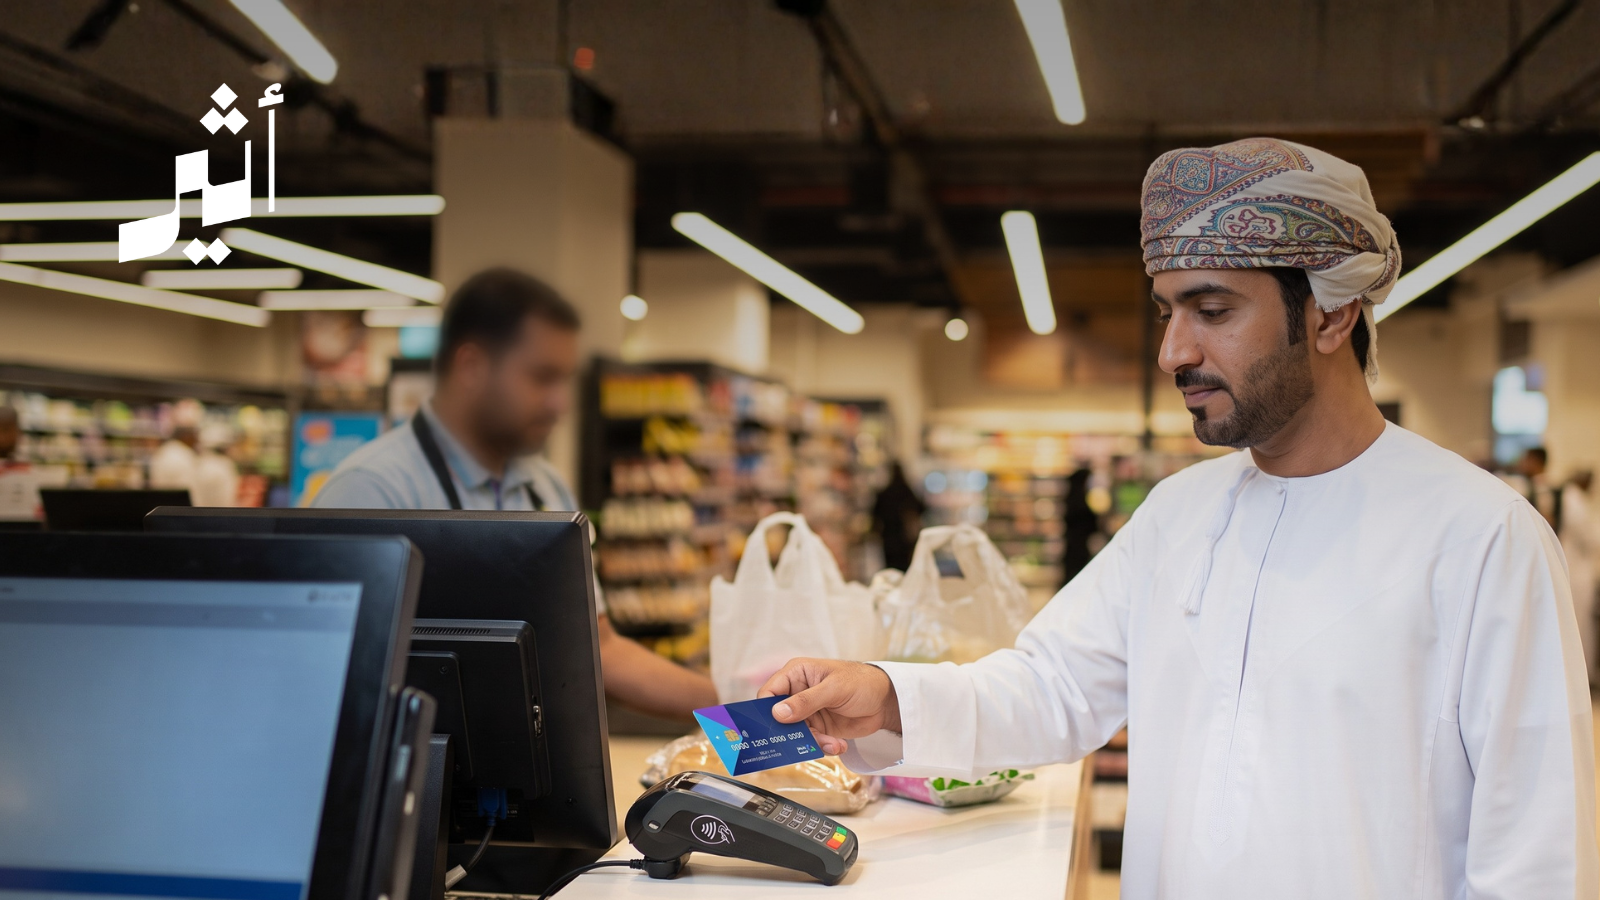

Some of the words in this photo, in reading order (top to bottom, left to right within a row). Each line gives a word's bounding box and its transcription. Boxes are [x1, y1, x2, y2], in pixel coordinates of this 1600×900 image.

[751, 738, 769, 748] 1200
[769, 735, 787, 744] 0000
[787, 731, 805, 740] 0000
